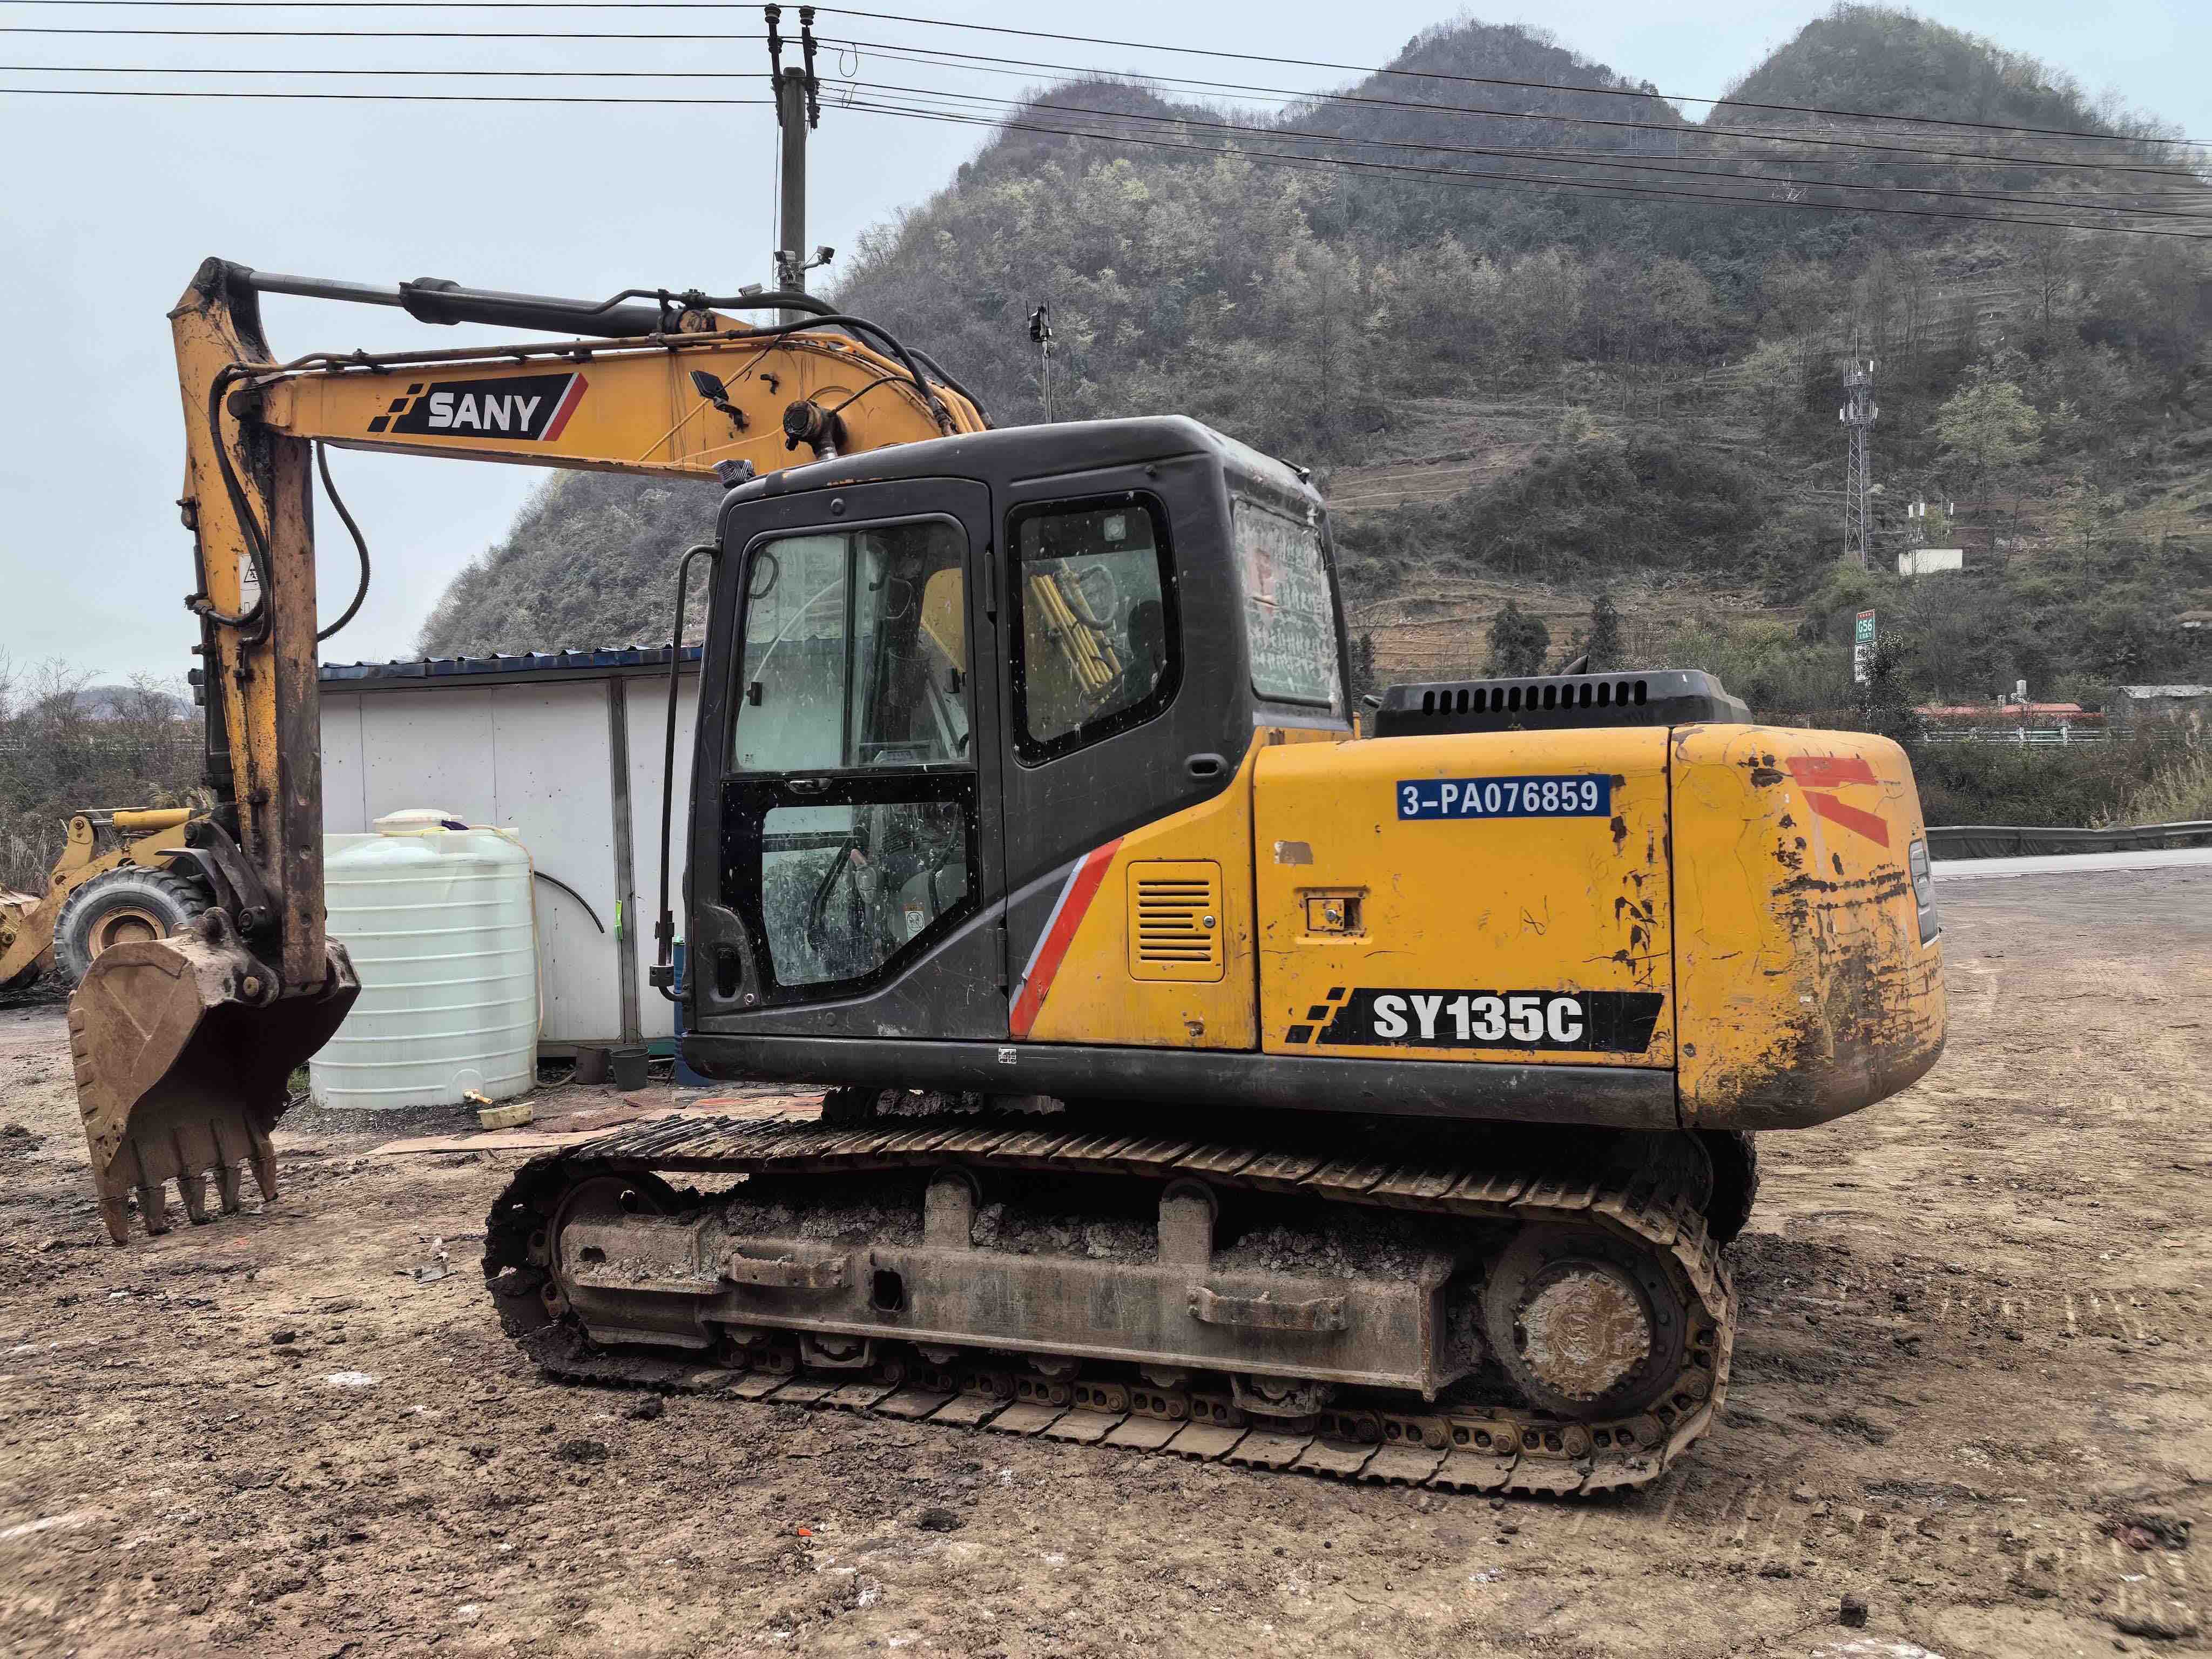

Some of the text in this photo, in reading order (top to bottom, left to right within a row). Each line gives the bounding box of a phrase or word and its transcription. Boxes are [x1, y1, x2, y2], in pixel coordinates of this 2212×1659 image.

[428, 392, 542, 431] SANY
[1858, 618, 1873, 633] G56
[1402, 781, 1597, 815] 3-PA076859
[1373, 995, 1582, 1041] SY135C
